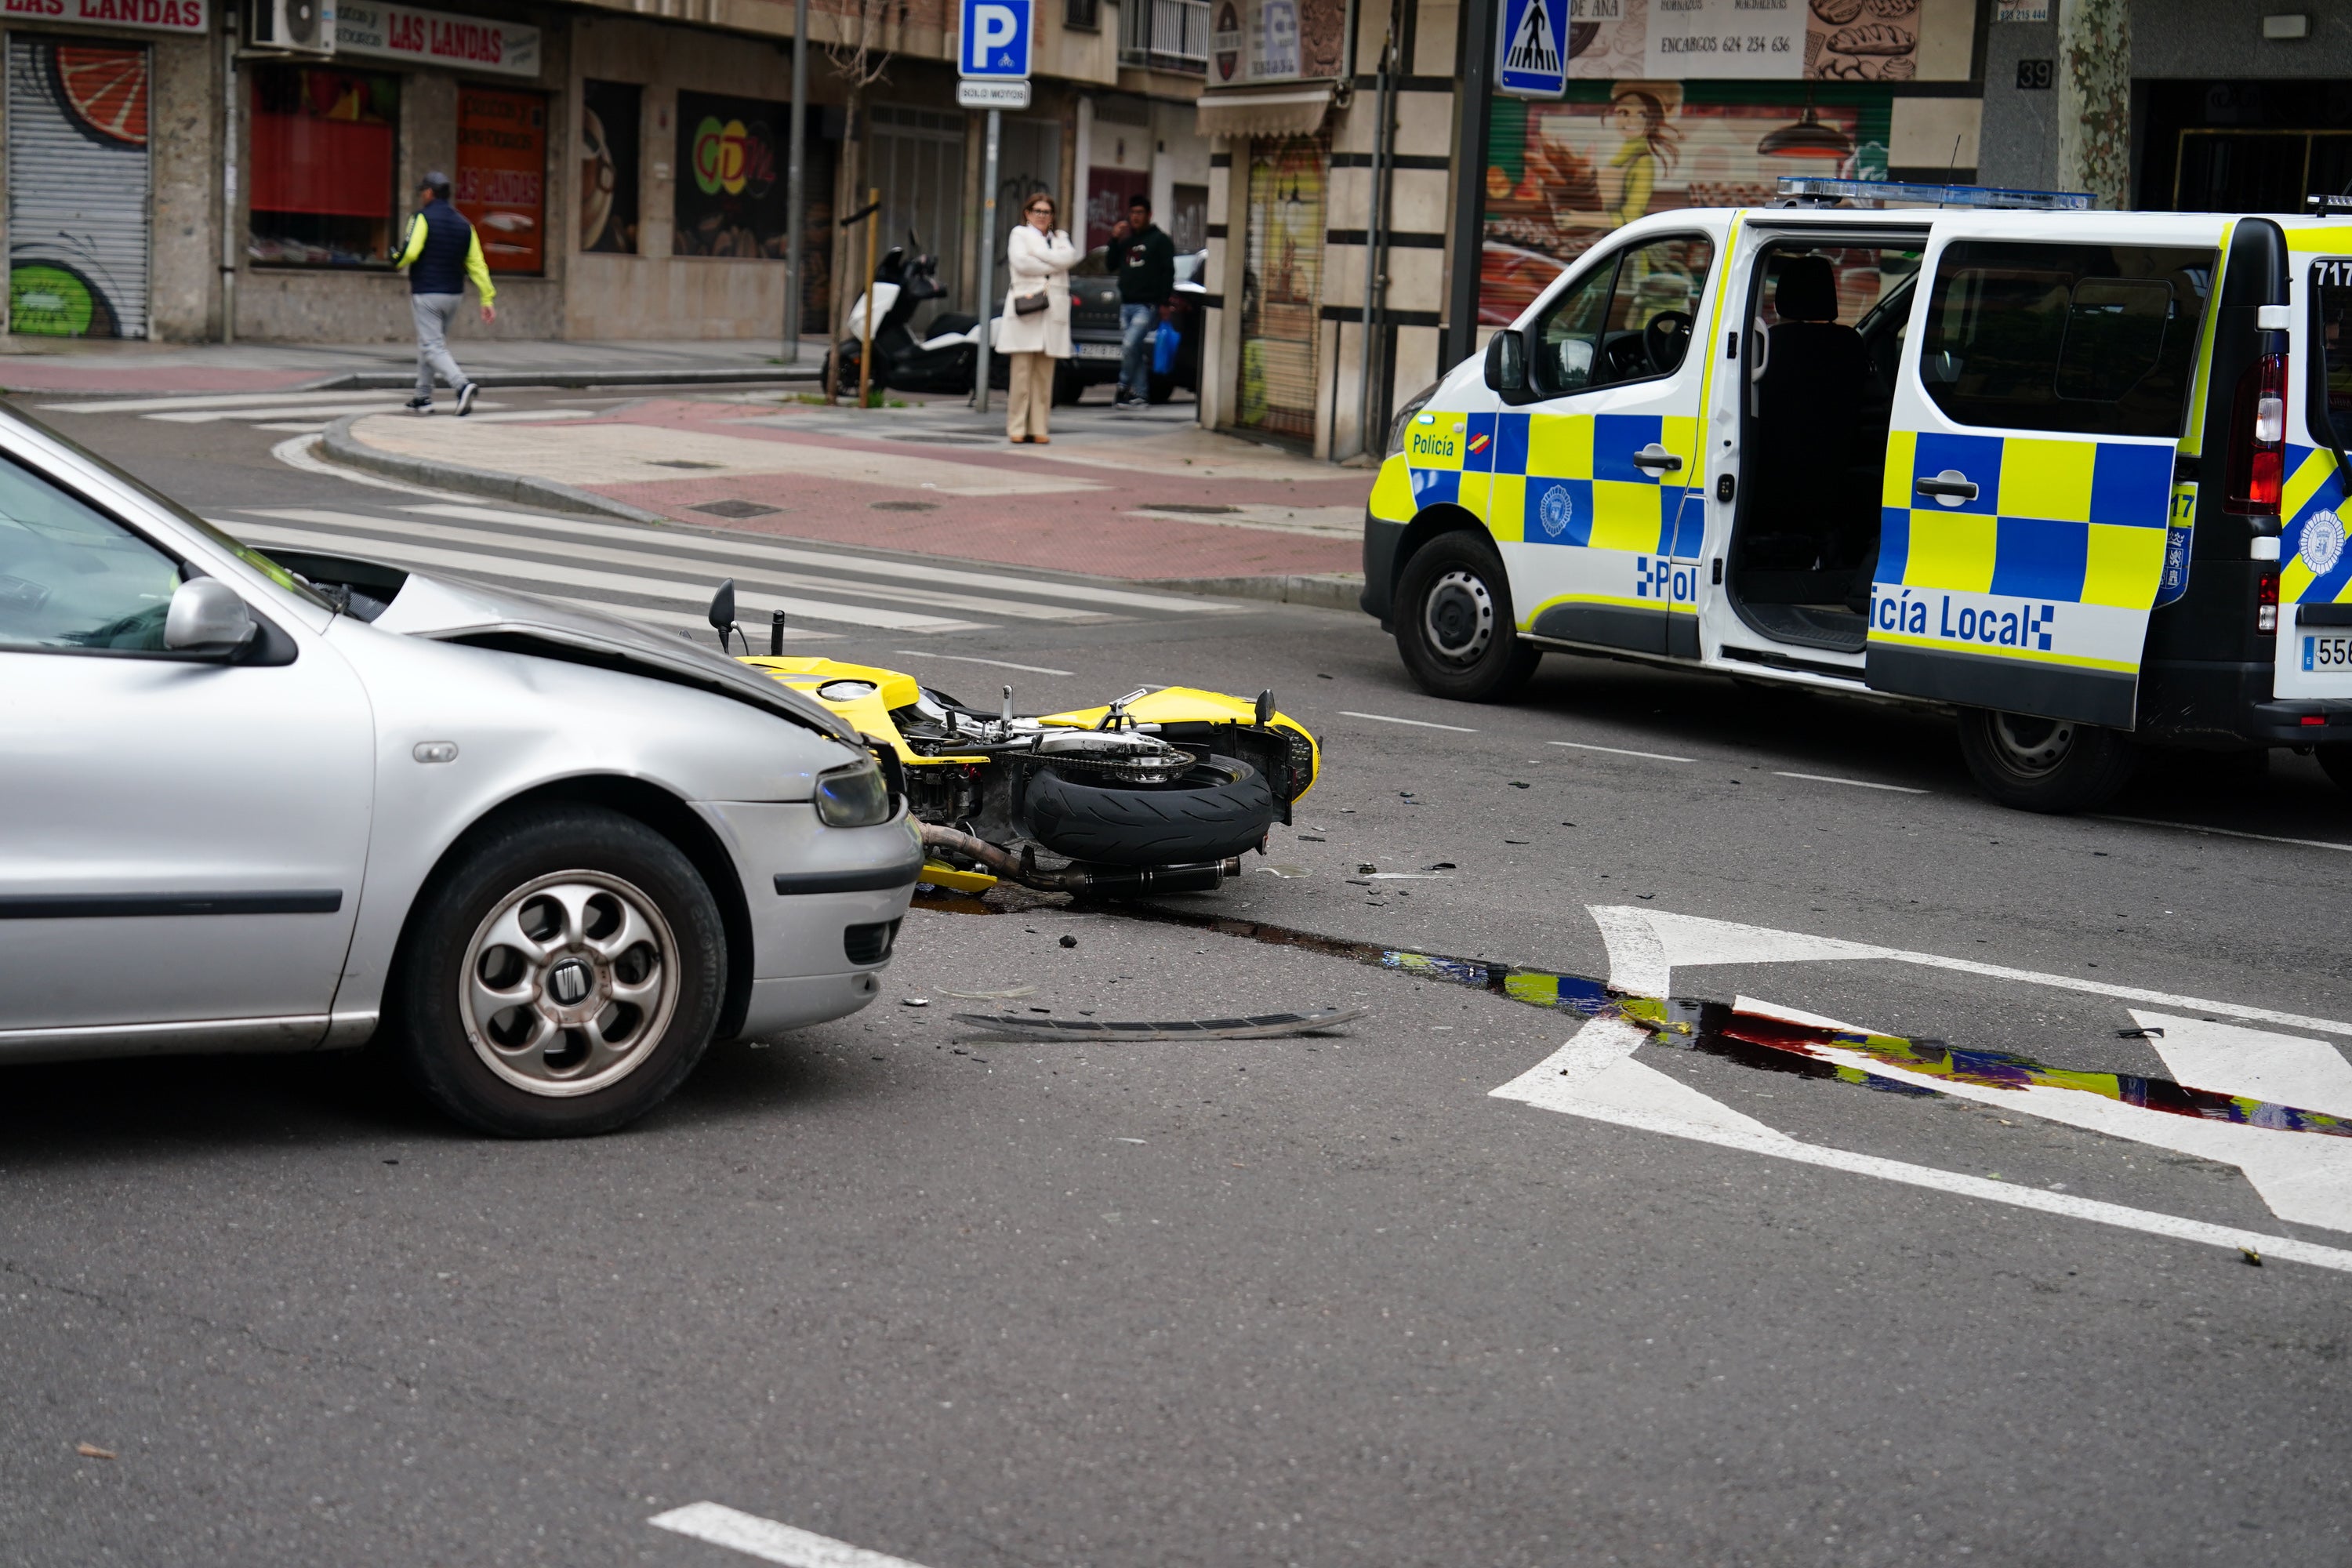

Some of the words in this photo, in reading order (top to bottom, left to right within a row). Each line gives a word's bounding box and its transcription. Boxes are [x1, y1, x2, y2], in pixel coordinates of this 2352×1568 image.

[5, 0, 64, 15] LAS
[79, 0, 201, 27] LANDAS
[1592, 0, 1618, 16] ANA
[388, 13, 424, 53] LAS
[430, 19, 502, 64] LANDAS
[973, 4, 1018, 68] P
[1661, 36, 1717, 53] ENCARGOS
[1722, 36, 1740, 53] 624
[1747, 36, 1766, 53] 234
[1772, 36, 1790, 53] 636
[2020, 62, 2049, 87] 39
[964, 88, 987, 98] SOLO
[990, 89, 1023, 99] MOTOS
[2315, 262, 2352, 286] 717
[1413, 434, 1454, 456] Policía
[1656, 561, 1696, 601] Pol
[1870, 586, 1926, 634] icía
[1940, 595, 2031, 647] Local
[2307, 656, 2312, 665] E
